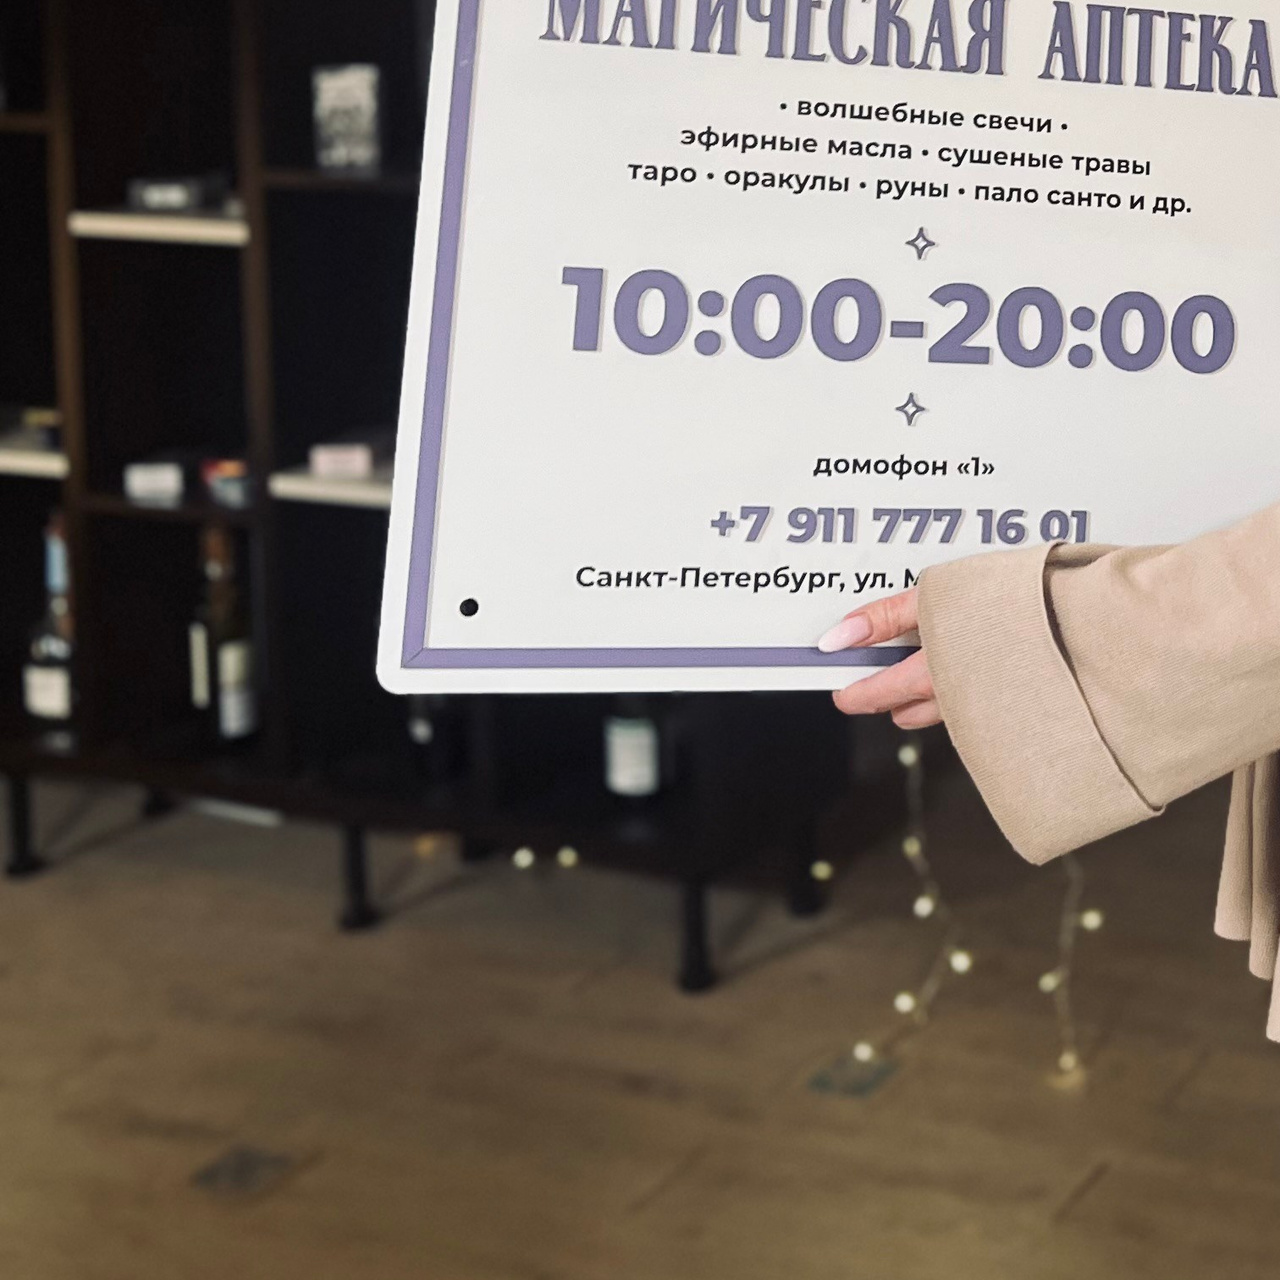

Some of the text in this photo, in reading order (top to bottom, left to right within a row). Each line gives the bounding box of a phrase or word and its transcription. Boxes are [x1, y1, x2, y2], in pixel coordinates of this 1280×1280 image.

[1036, 0, 1279, 99] АПТЕКА
[797, 100, 1052, 134] волшебные свечи
[680, 125, 1152, 178] эфирные масла сушеные травы
[627, 163, 1192, 218] таро оракулы руны пало санто и др.
[560, 266, 1237, 375] 10:00-20:00
[813, 453, 948, 481] домофон
[709, 506, 1089, 546] +7 911 777 16 01
[575, 564, 847, 594] Санкт-Петербург,
[852, 571, 895, 594] ул.
